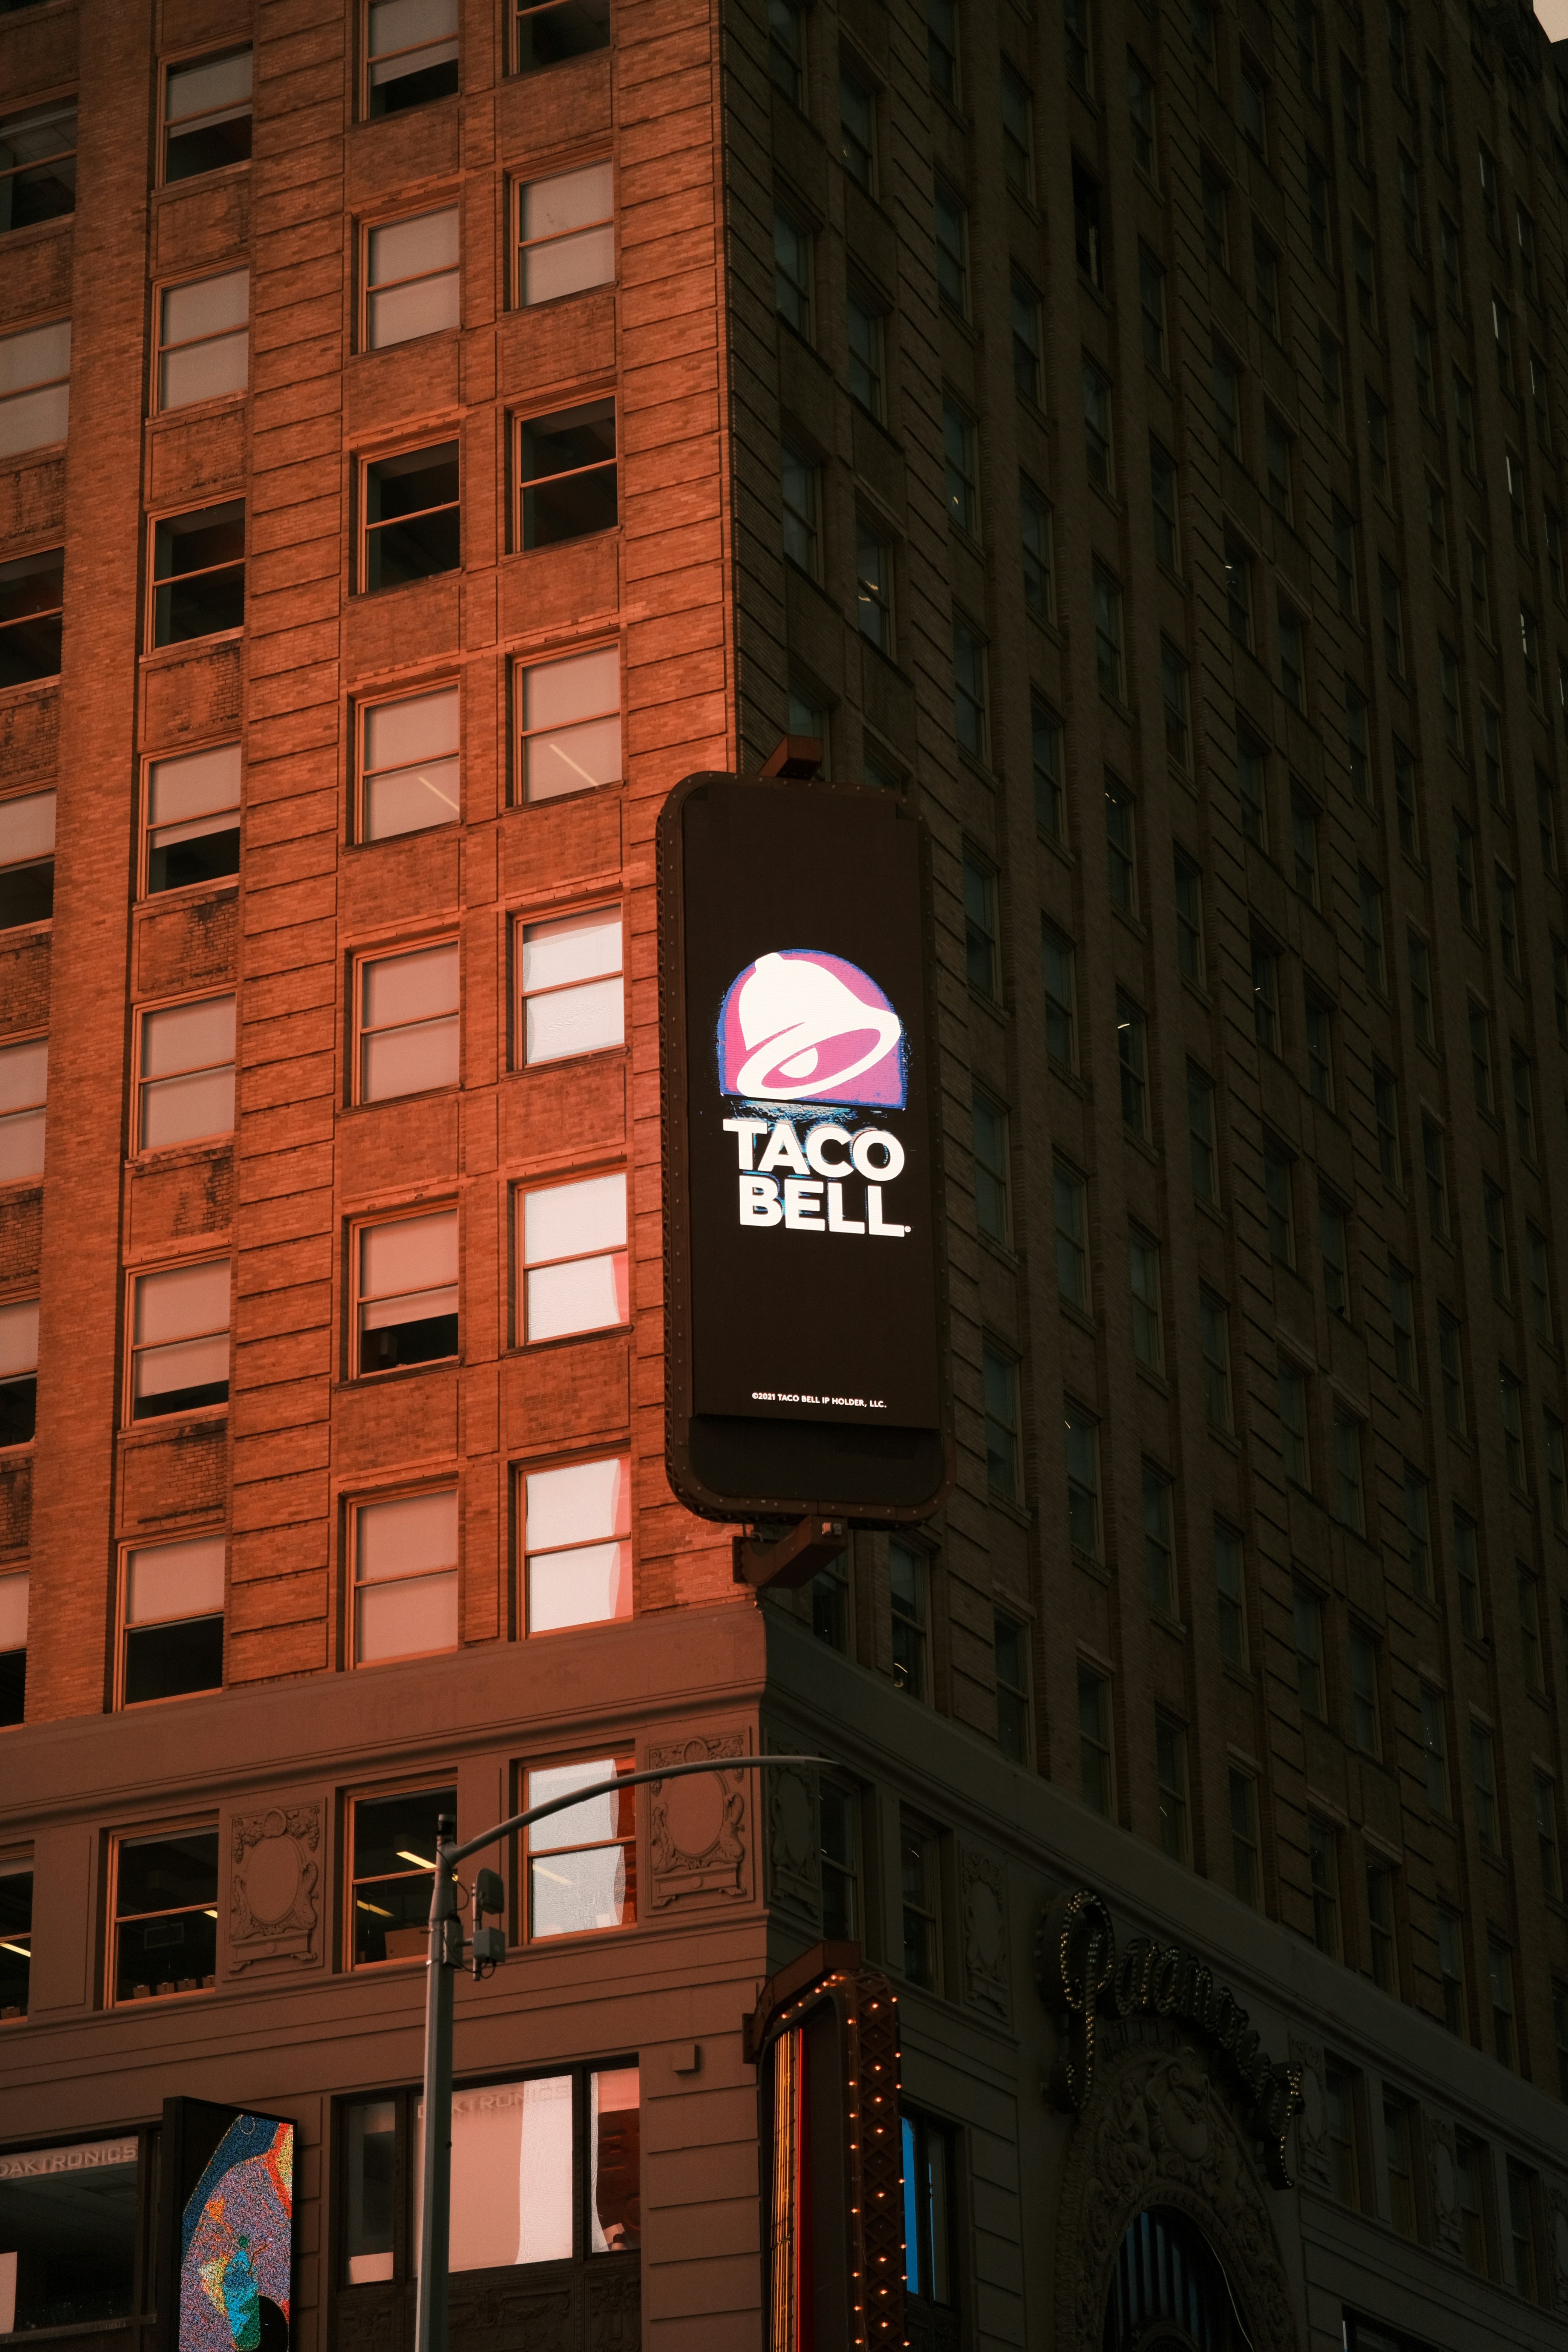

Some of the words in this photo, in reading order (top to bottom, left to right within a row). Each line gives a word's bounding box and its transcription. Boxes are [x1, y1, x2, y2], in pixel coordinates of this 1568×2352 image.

[723, 1117, 905, 1181] TACO
[777, 1393, 799, 1402] TACO
[801, 1395, 821, 1404] BELL
[831, 1397, 867, 1407] HOLDER,
